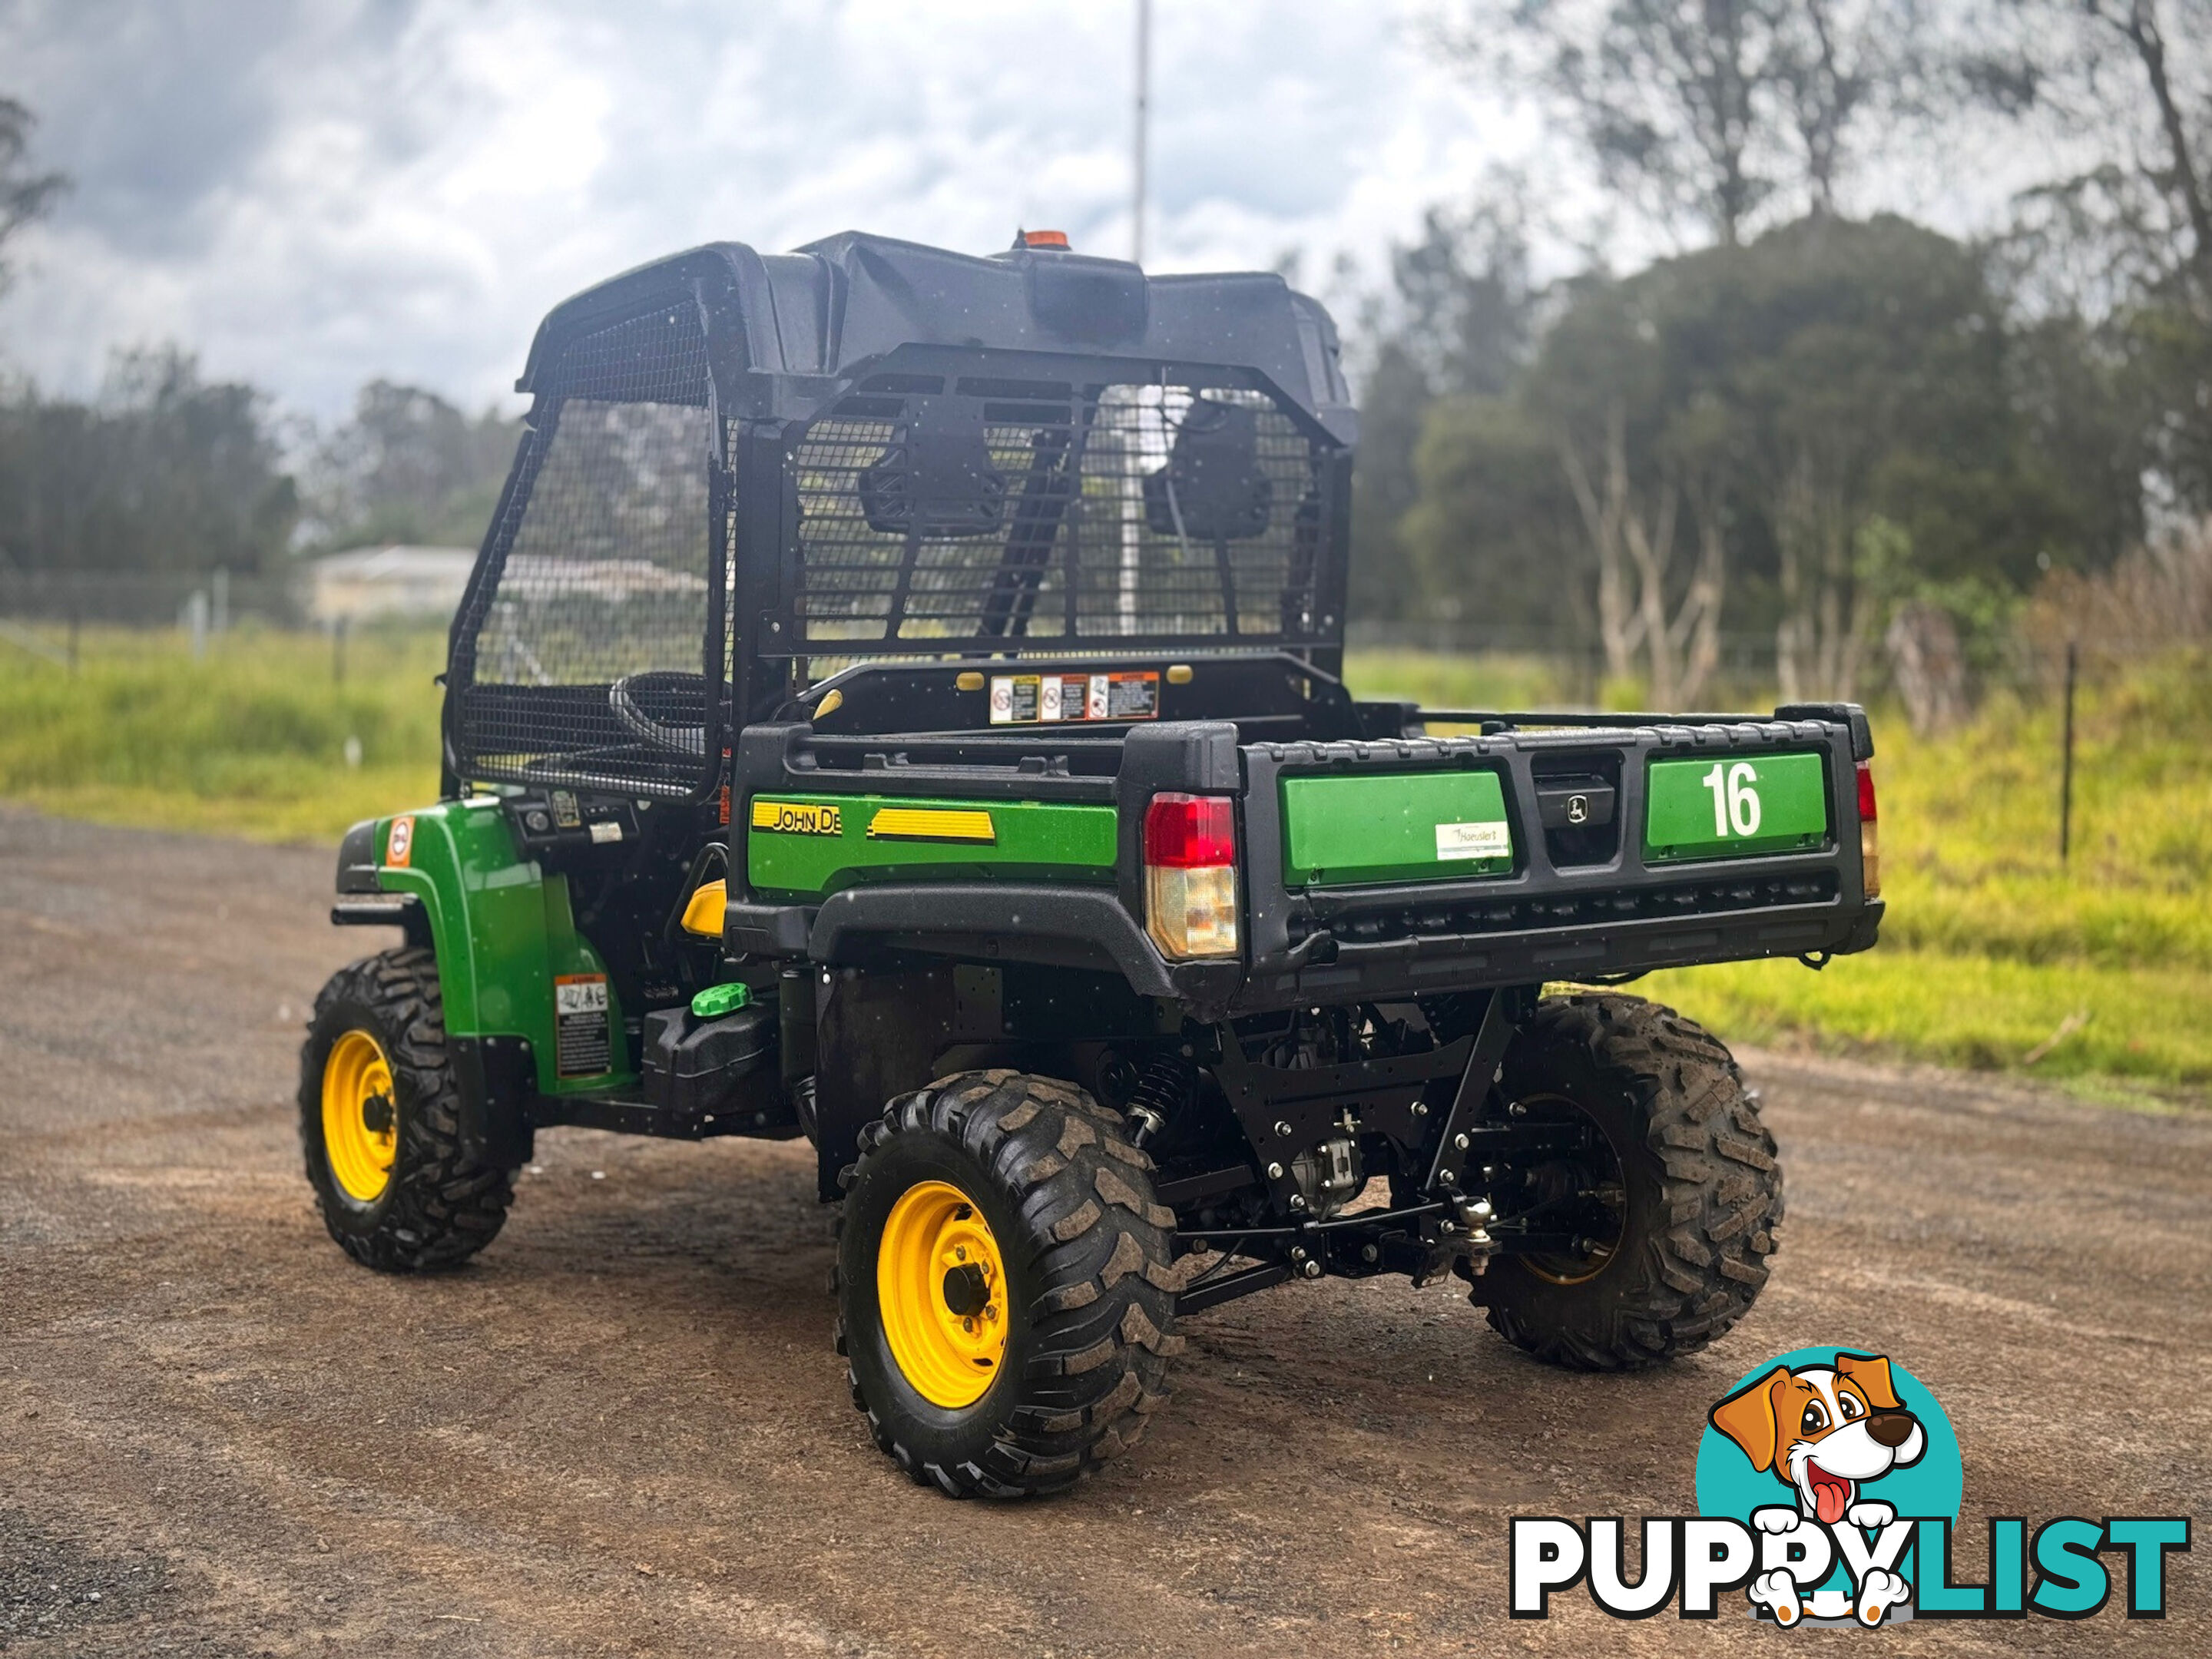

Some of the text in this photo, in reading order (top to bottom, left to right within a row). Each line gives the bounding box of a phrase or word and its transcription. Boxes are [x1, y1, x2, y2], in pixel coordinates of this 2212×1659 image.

[773, 806, 843, 831] JOHN DE
[1703, 762, 1761, 836] 16
